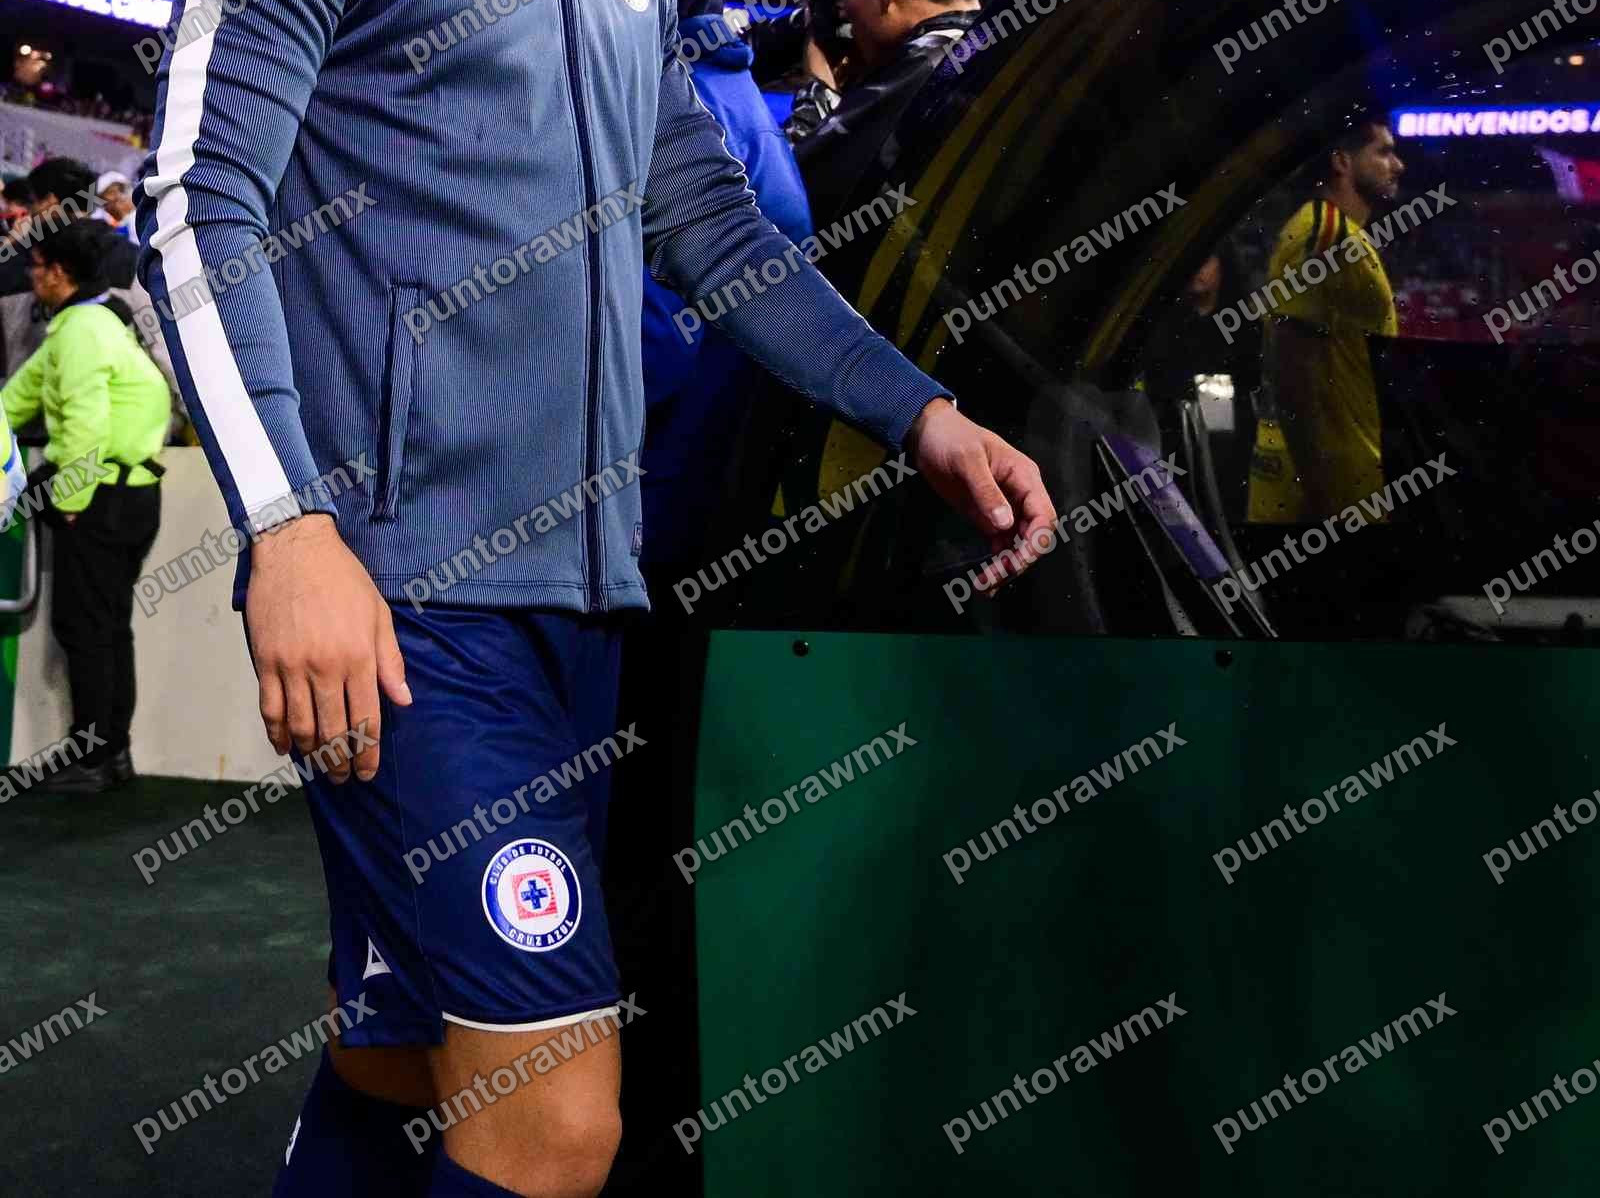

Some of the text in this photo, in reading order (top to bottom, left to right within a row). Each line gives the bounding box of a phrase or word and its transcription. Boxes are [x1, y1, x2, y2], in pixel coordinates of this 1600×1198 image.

[1398, 109, 1589, 137] BIENVENIDOS
[489, 845, 567, 885] CLUB DE FUTBOL
[508, 918, 575, 947] CRUZ AZUL
